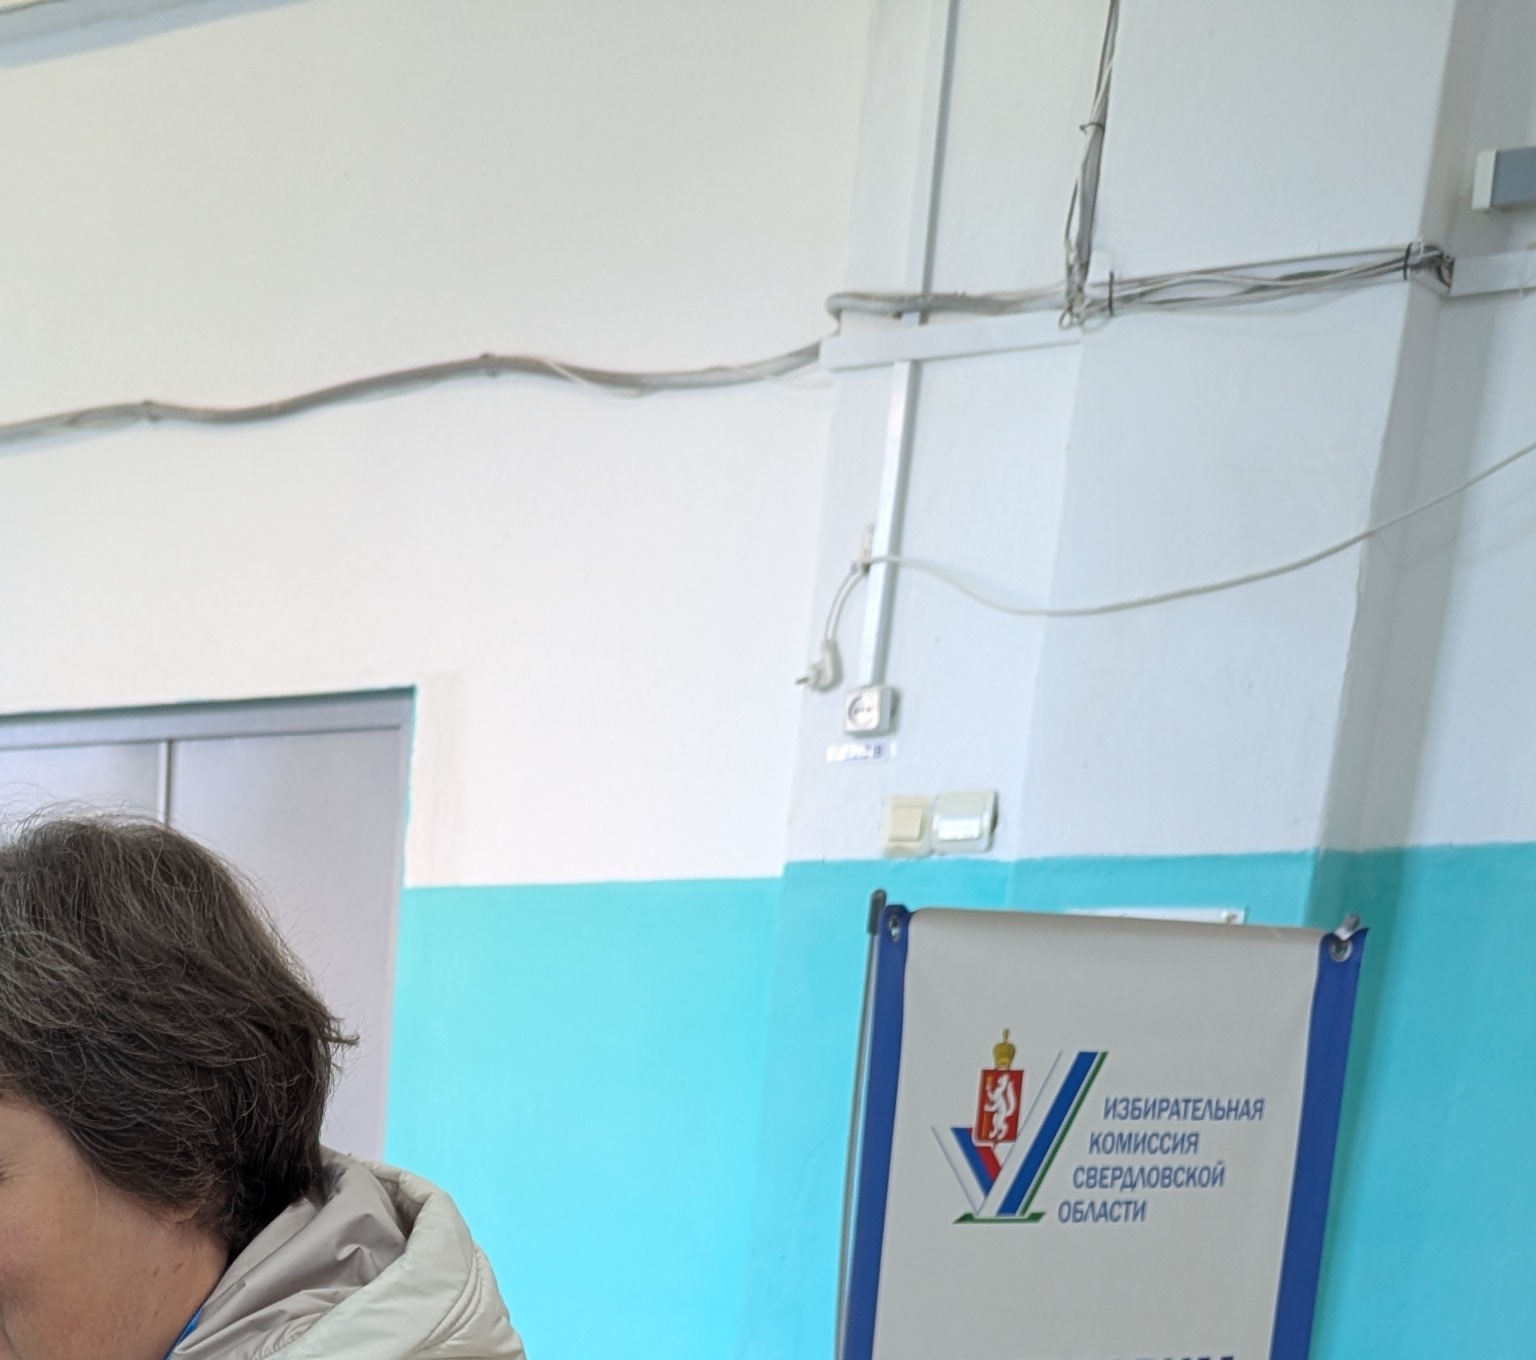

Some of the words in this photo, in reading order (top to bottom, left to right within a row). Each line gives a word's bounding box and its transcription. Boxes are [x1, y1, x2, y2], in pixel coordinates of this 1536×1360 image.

[1103, 1097, 1264, 1121] ИЗБИРАТЕЛЬНАЯ
[1089, 1132, 1199, 1155] КОМИССИЯ
[1073, 1161, 1225, 1192] СВЕРДЛОВСКОЙ
[1058, 1200, 1146, 1224] ОБЛАСТИ
